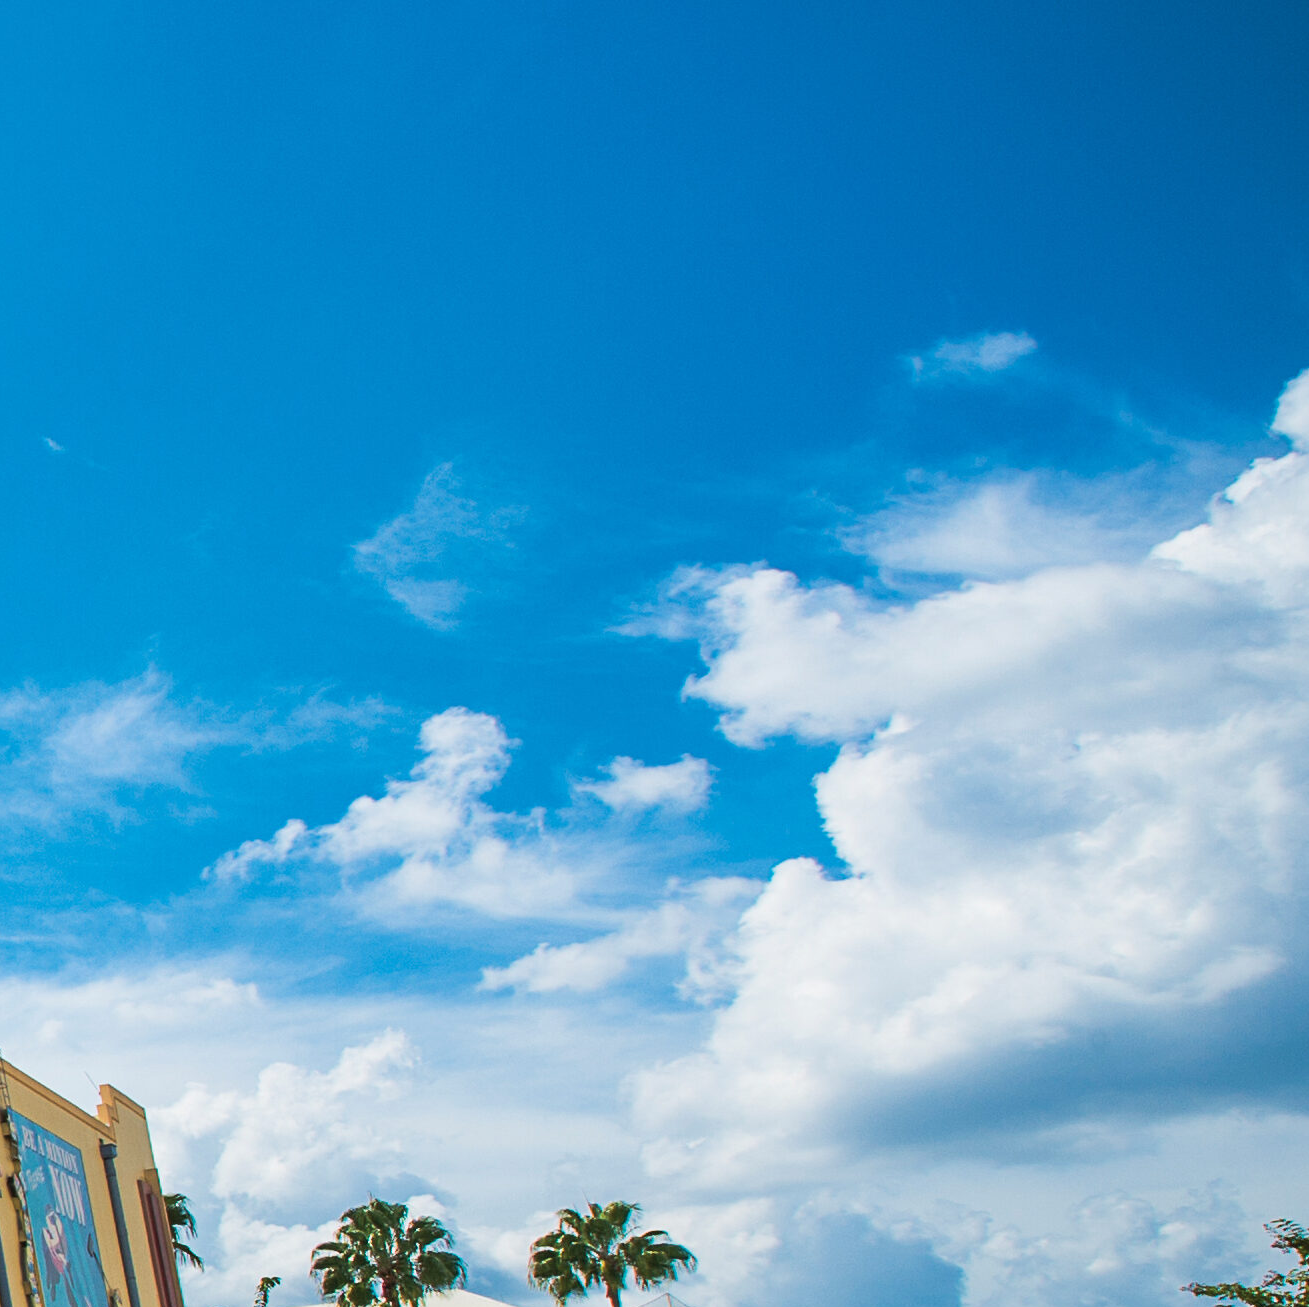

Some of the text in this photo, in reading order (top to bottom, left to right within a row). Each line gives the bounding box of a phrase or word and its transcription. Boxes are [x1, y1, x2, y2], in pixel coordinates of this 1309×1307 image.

[22, 1125, 80, 1175] BE A MINION
